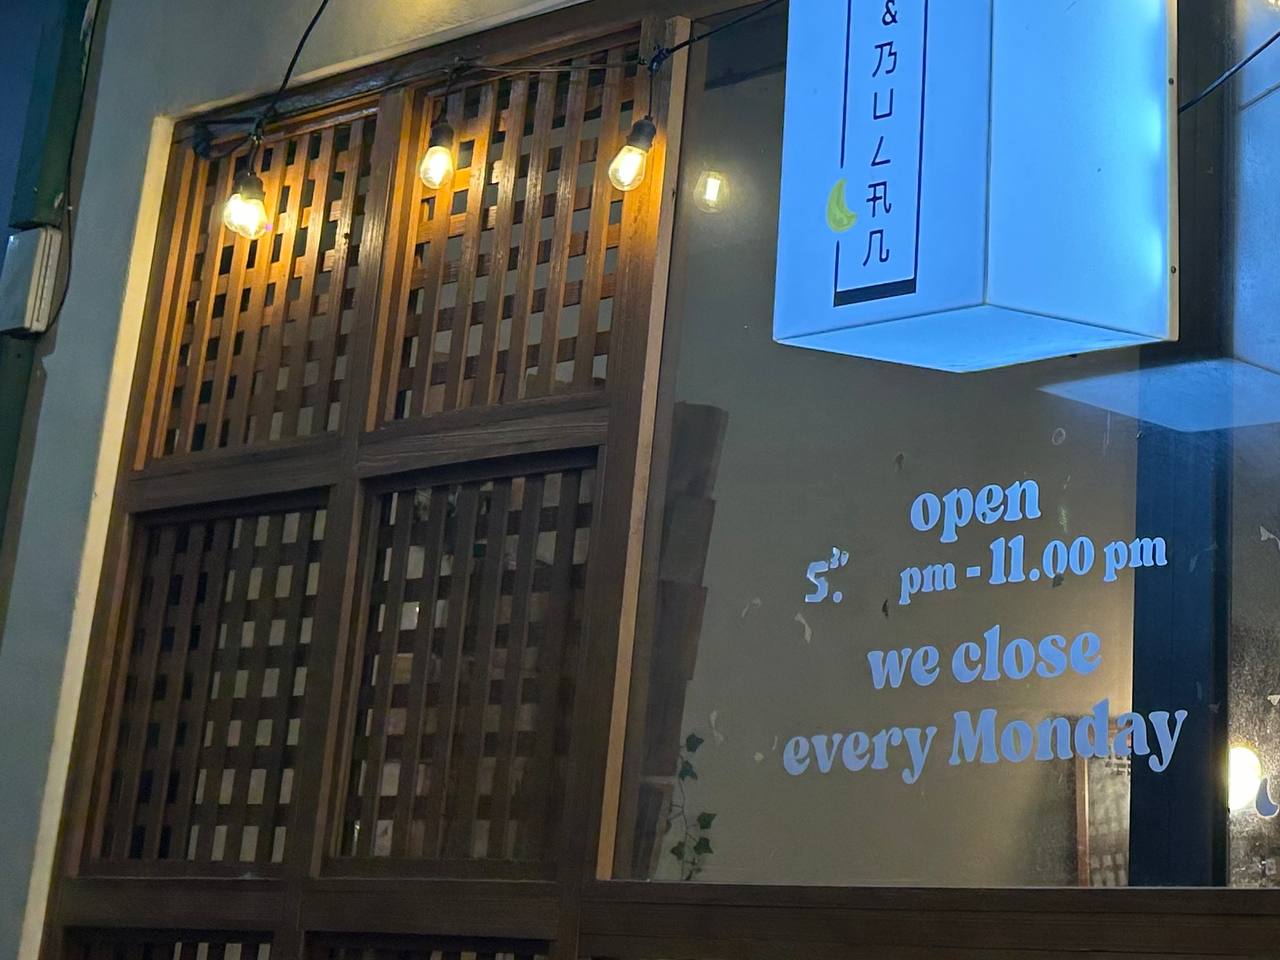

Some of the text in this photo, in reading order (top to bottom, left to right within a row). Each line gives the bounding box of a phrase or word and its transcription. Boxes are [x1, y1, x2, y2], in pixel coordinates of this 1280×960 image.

[910, 478, 1042, 543] open
[899, 559, 957, 605] pm
[988, 534, 1096, 585] 11.00
[1103, 535, 1168, 582] pm
[867, 624, 1101, 689] we close
[782, 697, 1188, 784] every Monday
